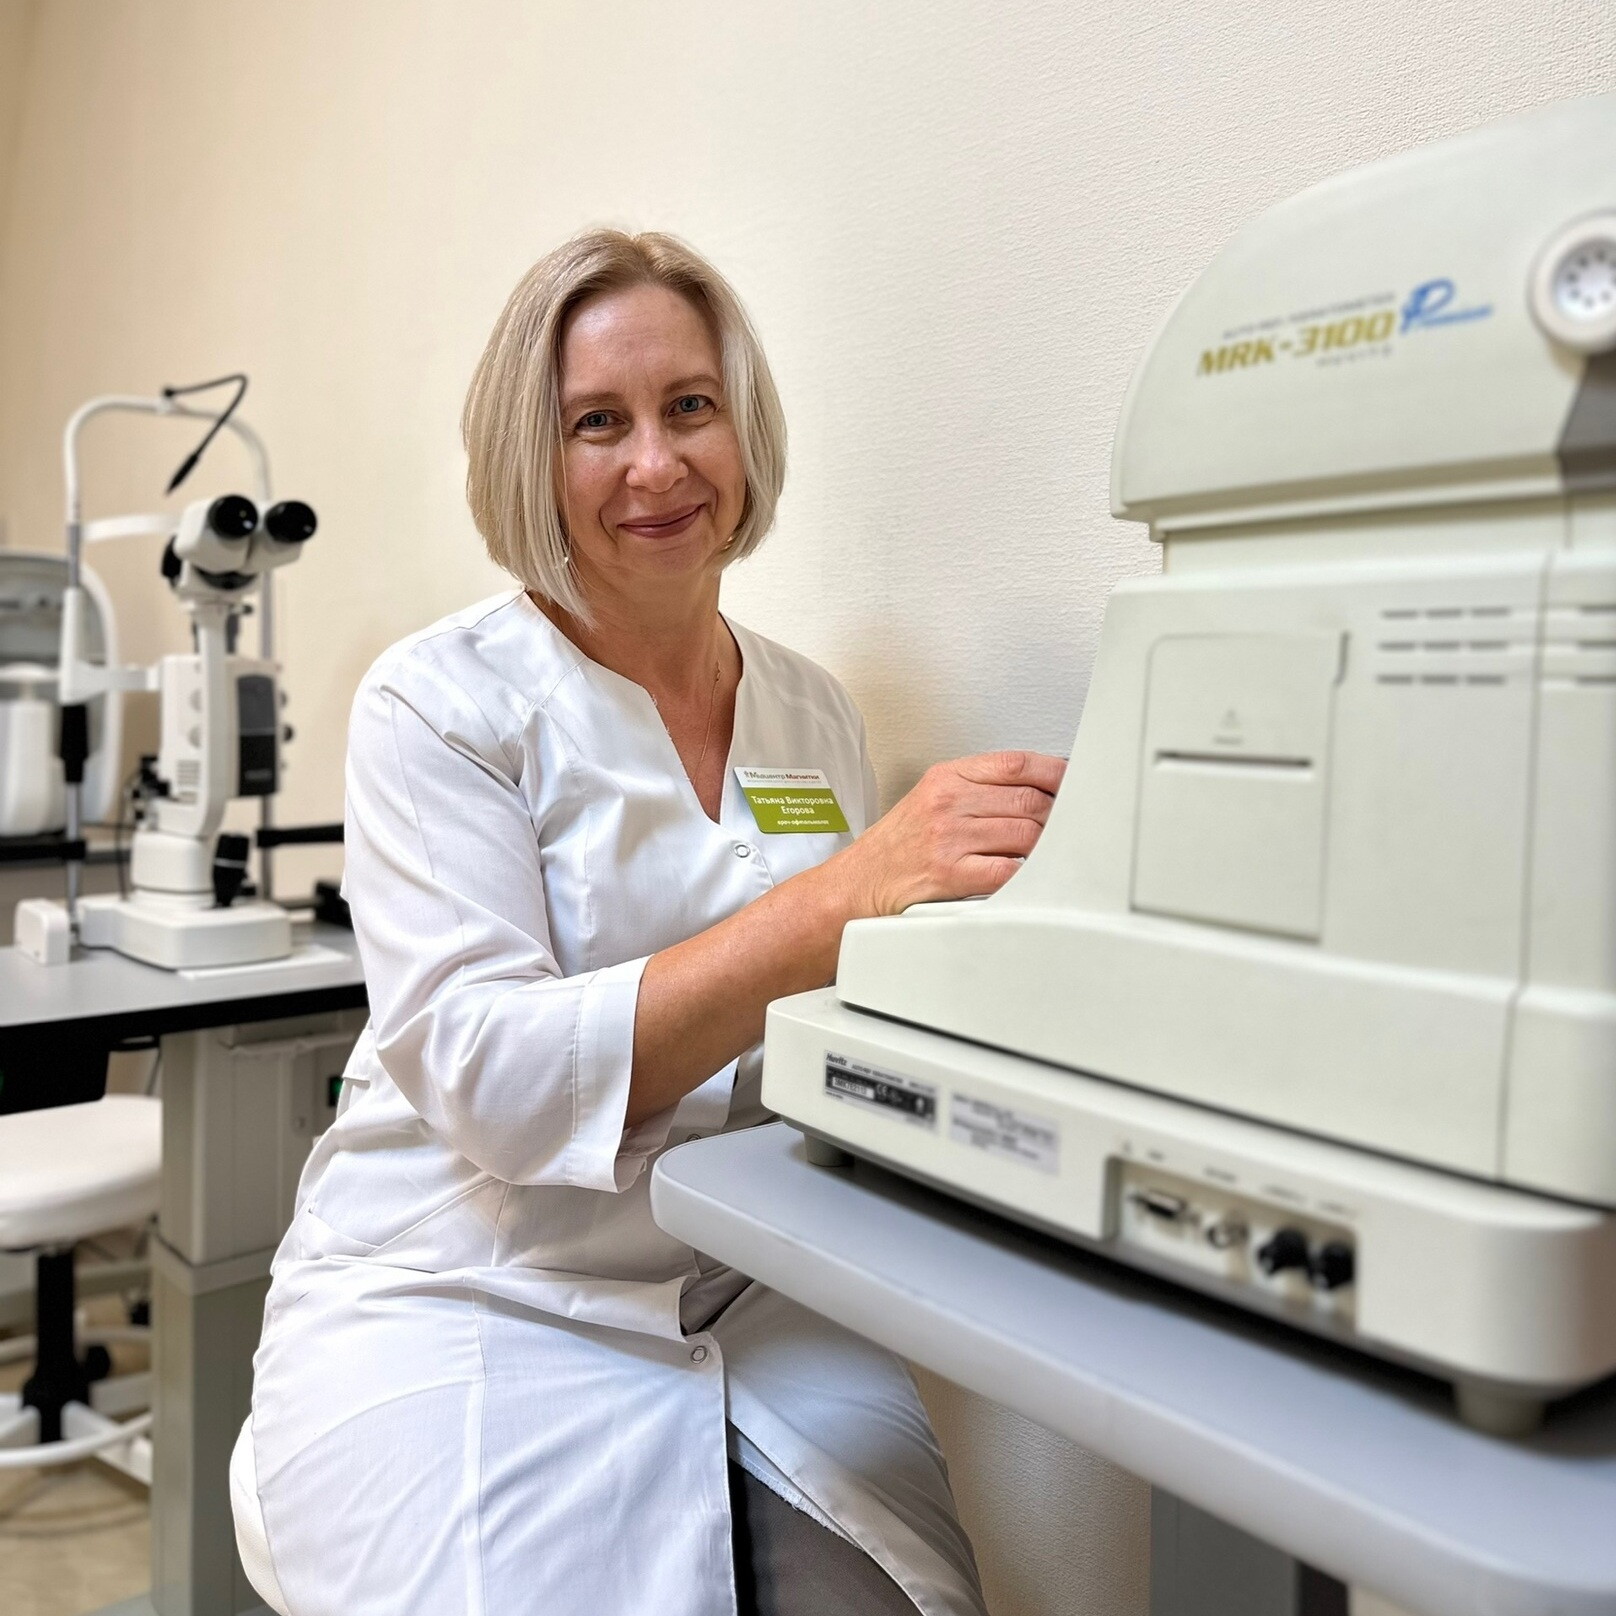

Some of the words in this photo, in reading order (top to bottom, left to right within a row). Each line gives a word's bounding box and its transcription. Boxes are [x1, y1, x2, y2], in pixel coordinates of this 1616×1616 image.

[1197, 309, 1396, 376] MRK-3100
[751, 795, 785, 804] Татьяна
[786, 796, 833, 805] Викторовна
[781, 806, 815, 815] Егорова
